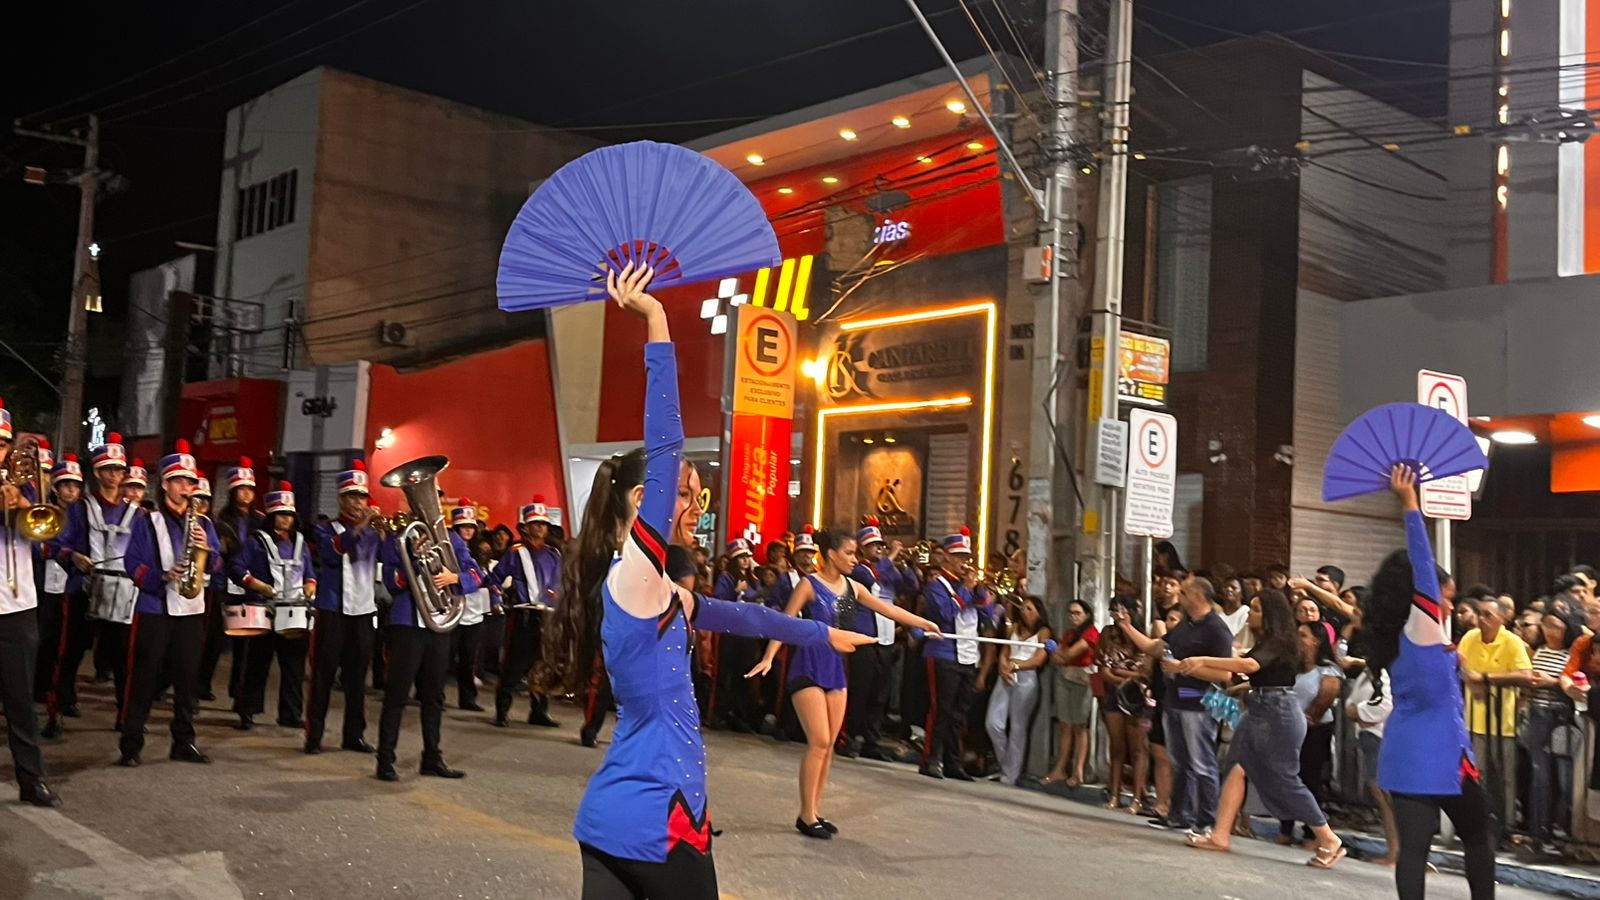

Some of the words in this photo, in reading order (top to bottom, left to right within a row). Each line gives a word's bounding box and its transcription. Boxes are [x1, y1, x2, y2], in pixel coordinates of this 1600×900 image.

[756, 327, 778, 364] E
[1149, 430, 1158, 456] E
[745, 447, 767, 524] Ultra
[767, 450, 778, 496] Popular
